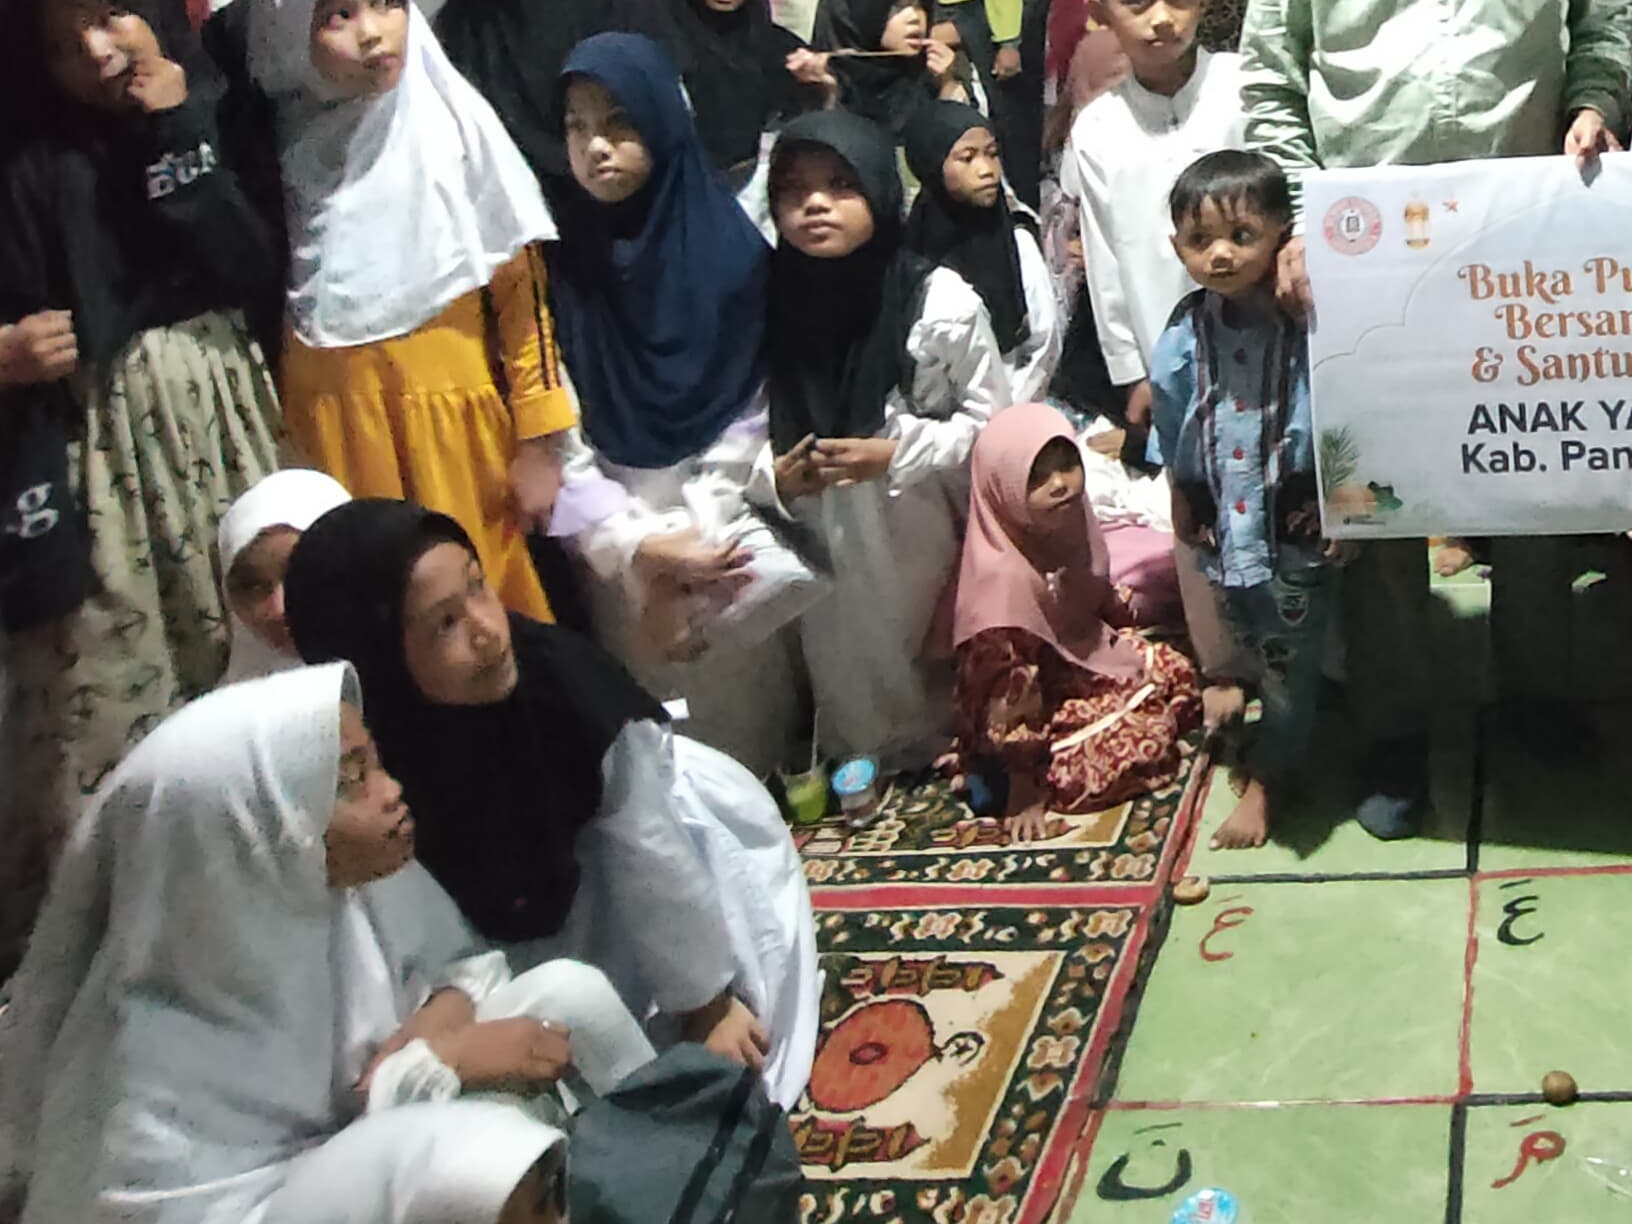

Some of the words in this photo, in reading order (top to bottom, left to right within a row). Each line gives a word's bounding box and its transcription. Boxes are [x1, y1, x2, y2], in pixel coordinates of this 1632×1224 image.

[1457, 260, 1573, 304] Buka
[1471, 346, 1503, 383] &
[1468, 401, 1588, 434] ANAK
[1461, 441, 1547, 474] Kab.
